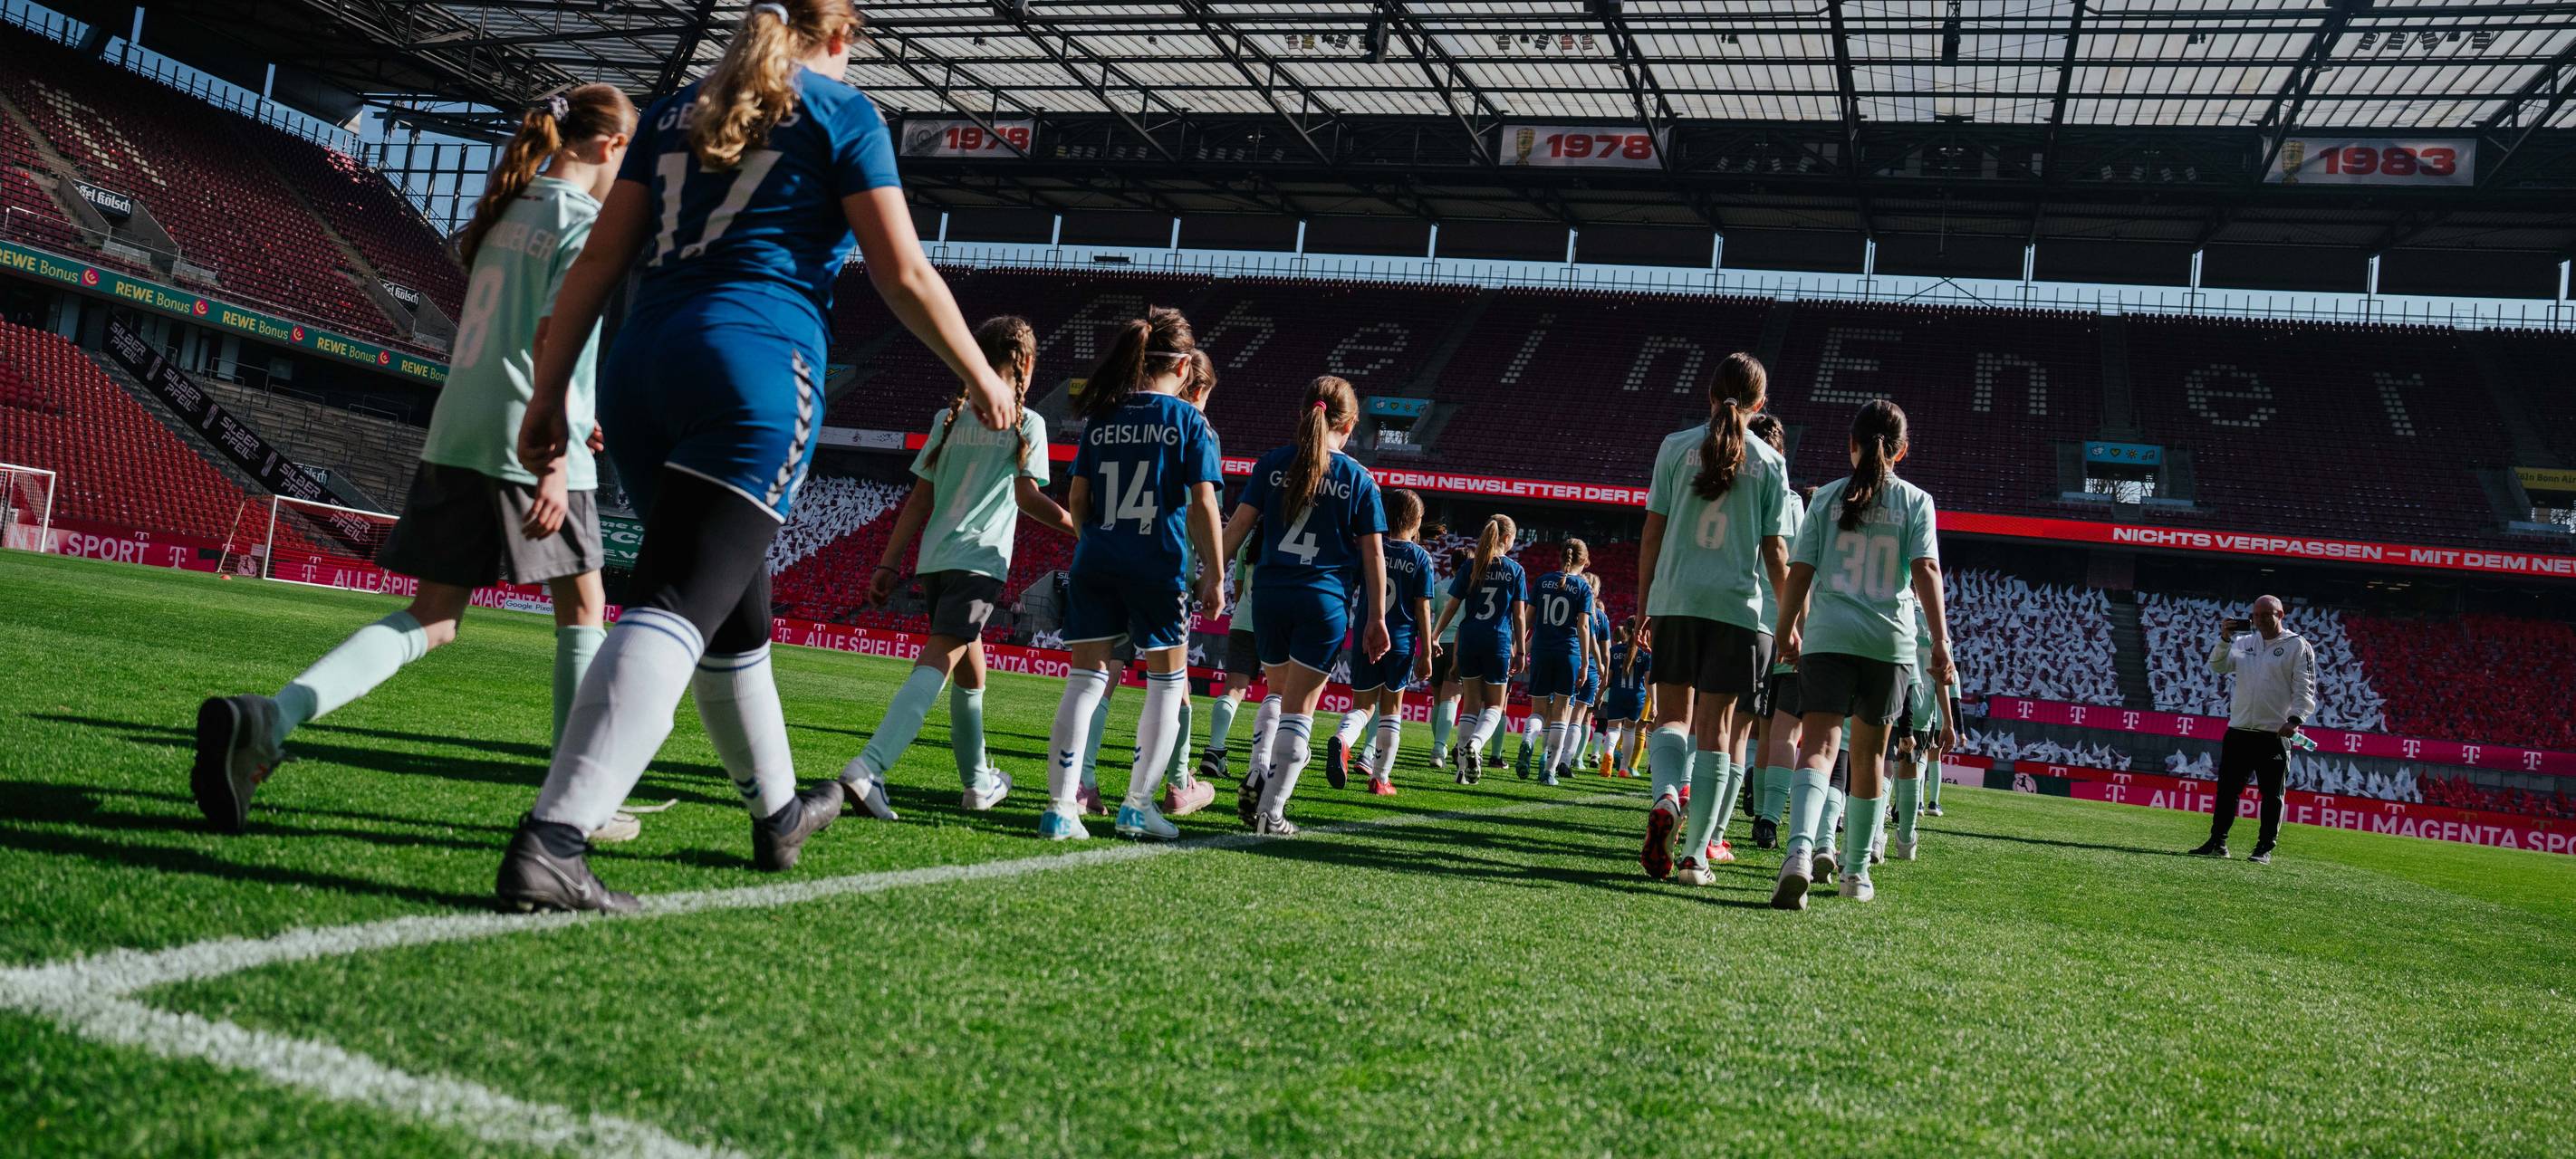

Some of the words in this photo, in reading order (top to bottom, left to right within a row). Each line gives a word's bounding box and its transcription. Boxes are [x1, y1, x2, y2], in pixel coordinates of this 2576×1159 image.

[946, 127, 1030, 152] 1978
[1546, 133, 1653, 160] 1978
[2319, 147, 2456, 177] 1983
[648, 149, 784, 267] 17
[40, 259, 79, 283] Bonus
[115, 281, 154, 303] REWE
[156, 292, 190, 313] Bonus
[222, 310, 256, 331] REWE
[258, 320, 289, 340] Bonus
[453, 265, 505, 369] 8
[110, 321, 147, 356] SILBER
[110, 335, 140, 364] PFEIL
[317, 336, 347, 356] REWE
[349, 345, 376, 363] Bonus
[163, 368, 201, 403] SILBER
[401, 359, 428, 378] REWE
[430, 367, 449, 382] Bon
[164, 383, 192, 412] PFEIL
[220, 416, 260, 451] SILBER
[221, 432, 250, 460] PFEIL
[1090, 424, 1178, 446] GEISLING
[279, 463, 322, 498] SILBER
[1389, 472, 1436, 487] DEM
[1437, 475, 1581, 499] NEWSLETTER
[1583, 486, 1630, 503] DER
[1098, 460, 1158, 535] 14
[1277, 505, 1321, 565] 4
[1696, 493, 1729, 551] 6
[67, 532, 149, 564] SPORT
[2112, 526, 2212, 547] NICHTS
[2214, 534, 2383, 560] VERPASSEN
[2409, 548, 2460, 566] MIT
[2463, 552, 2527, 570] DEM
[2531, 556, 2576, 573] NE
[1385, 556, 1414, 573] SLING
[1485, 571, 1513, 581] SLING
[1831, 530, 1901, 601] 30
[333, 569, 377, 592] ALLE
[380, 574, 419, 597] SPIE
[1542, 580, 1578, 595] GEISNG
[505, 599, 533, 610] Google
[535, 604, 553, 612] Pixel
[1475, 587, 1499, 620] 3
[1543, 594, 1570, 627] 10
[804, 631, 845, 651] ALLE
[848, 637, 906, 658] SPIELE
[985, 653, 1029, 674] ENTA
[1033, 658, 1072, 678] SPO
[2372, 813, 2519, 849] MAGENTA
